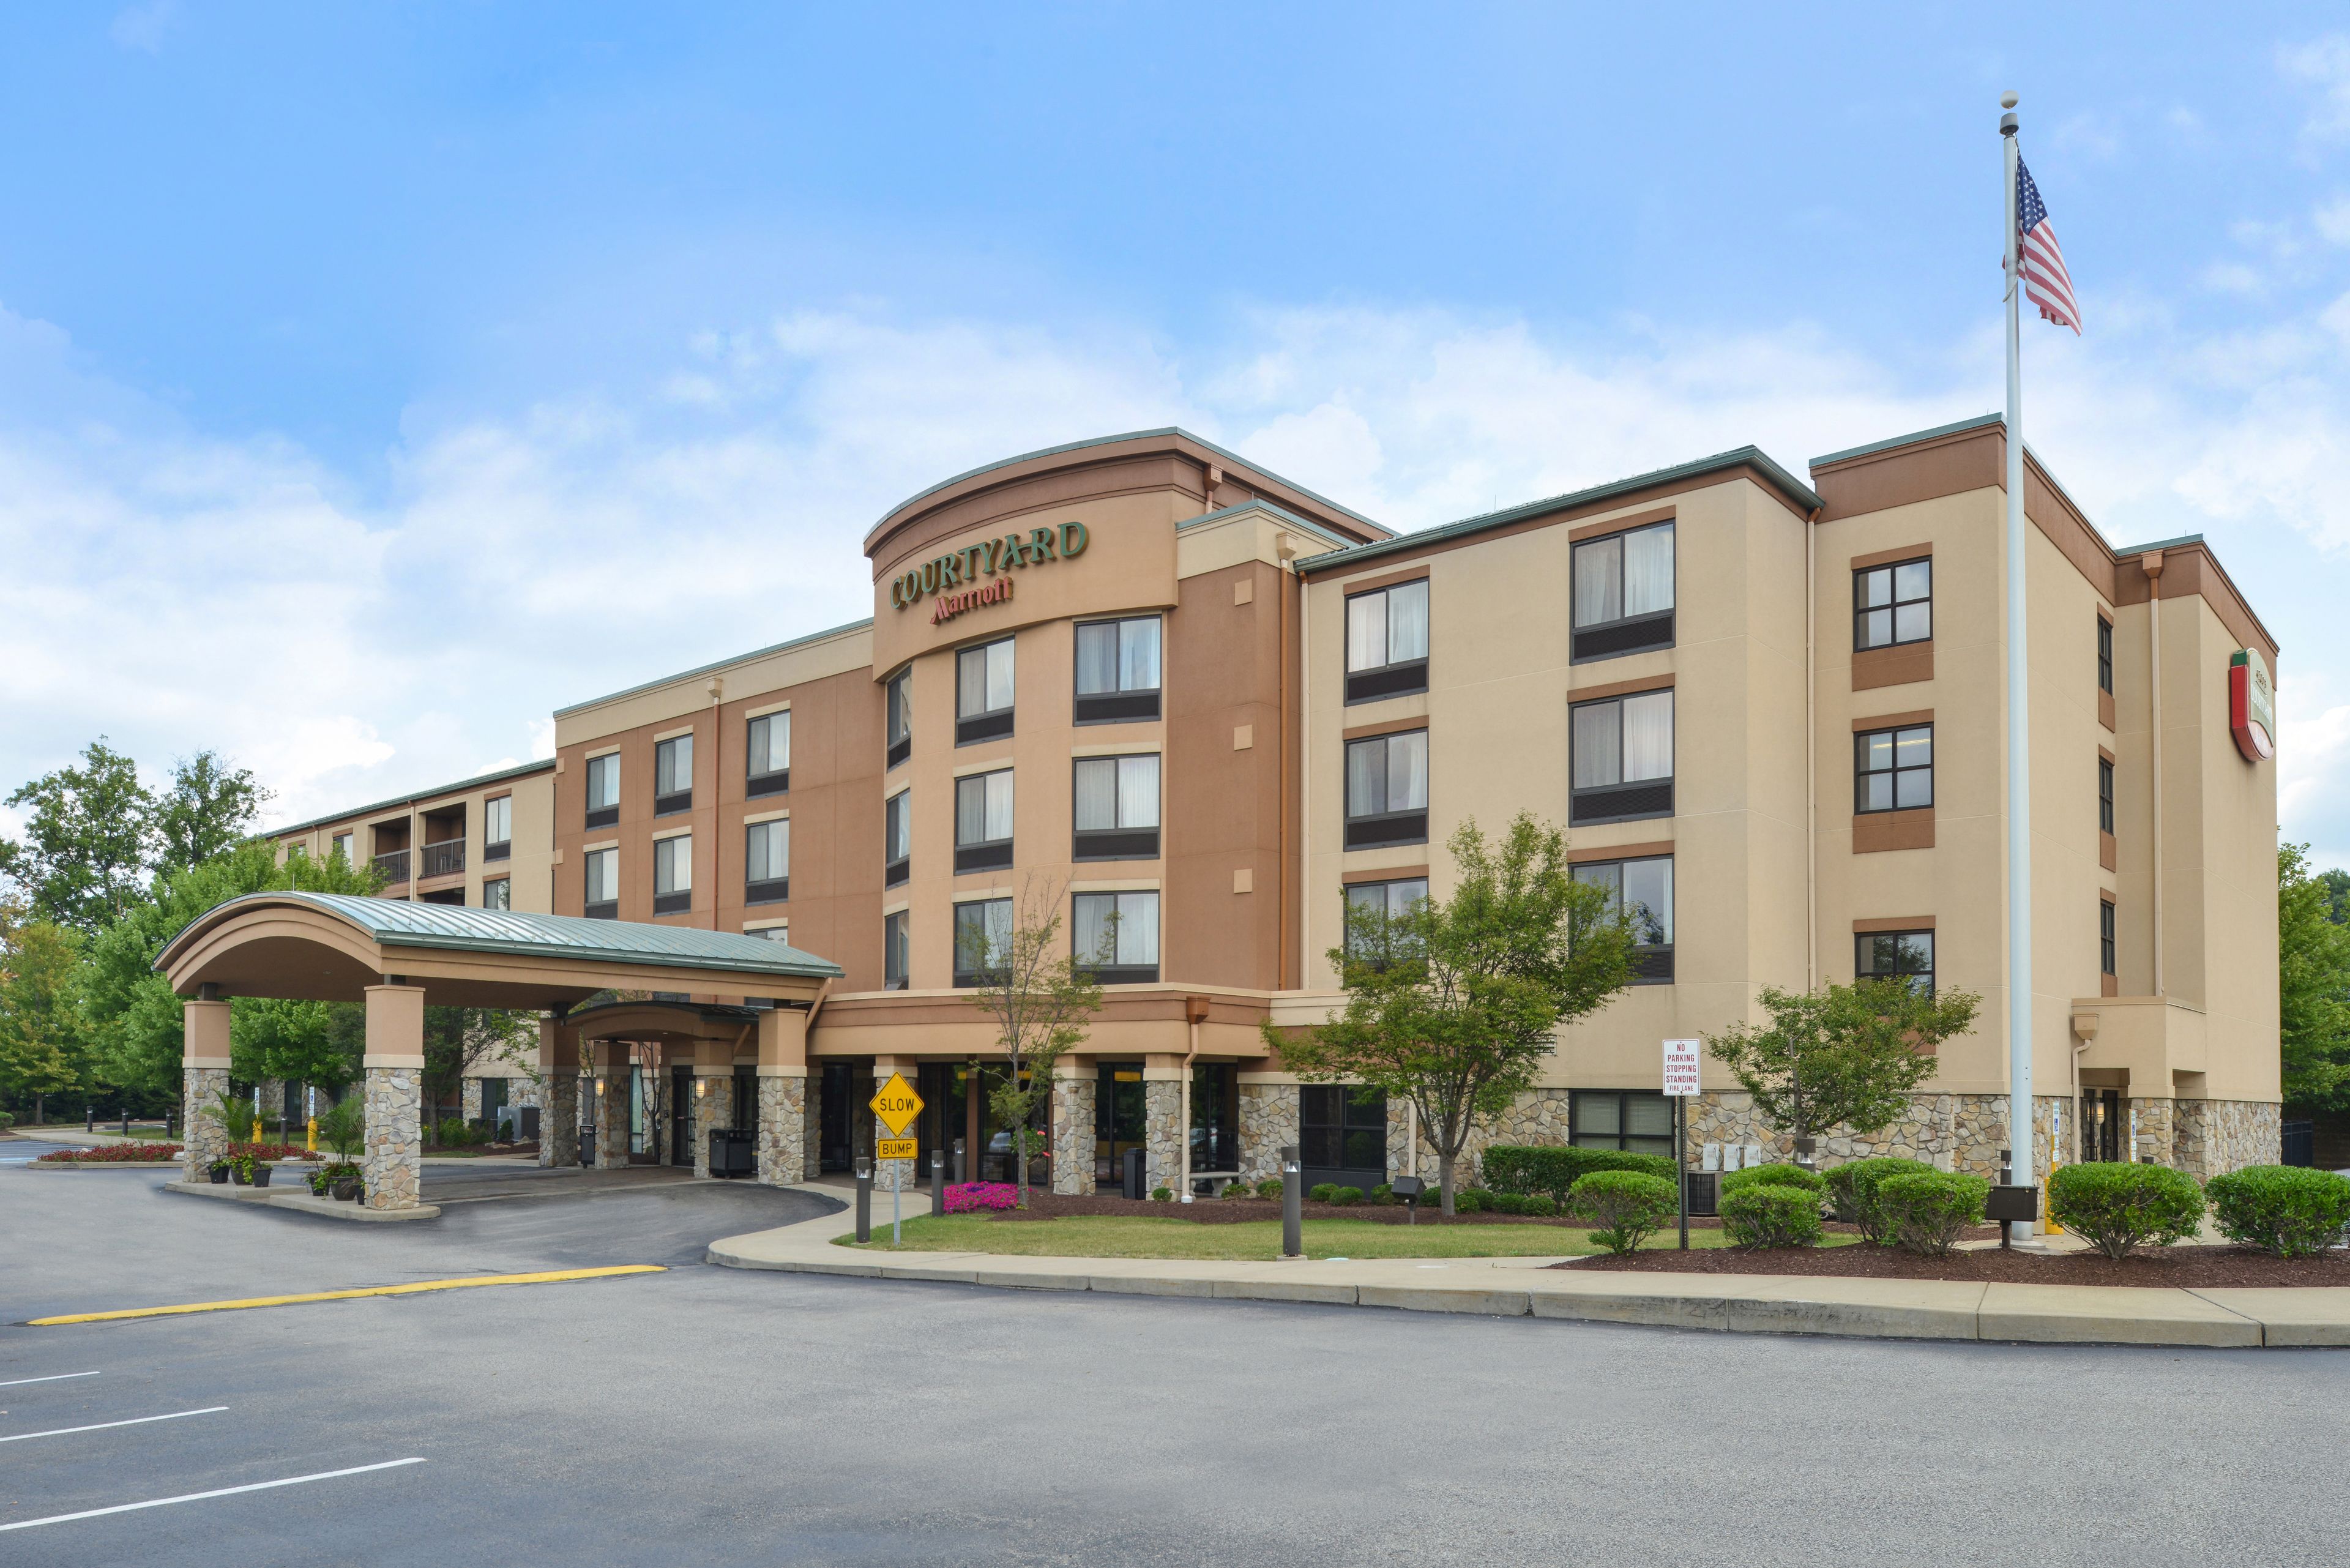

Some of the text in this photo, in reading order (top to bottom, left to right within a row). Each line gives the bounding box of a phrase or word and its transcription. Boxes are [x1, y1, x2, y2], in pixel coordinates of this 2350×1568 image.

[890, 521, 1089, 610] COURTYARD
[930, 576, 1013, 625] Marriott
[1666, 1064, 1696, 1073] STOPPING
[880, 1098, 914, 1111] SLOW
[882, 1143, 912, 1154] BUMP
